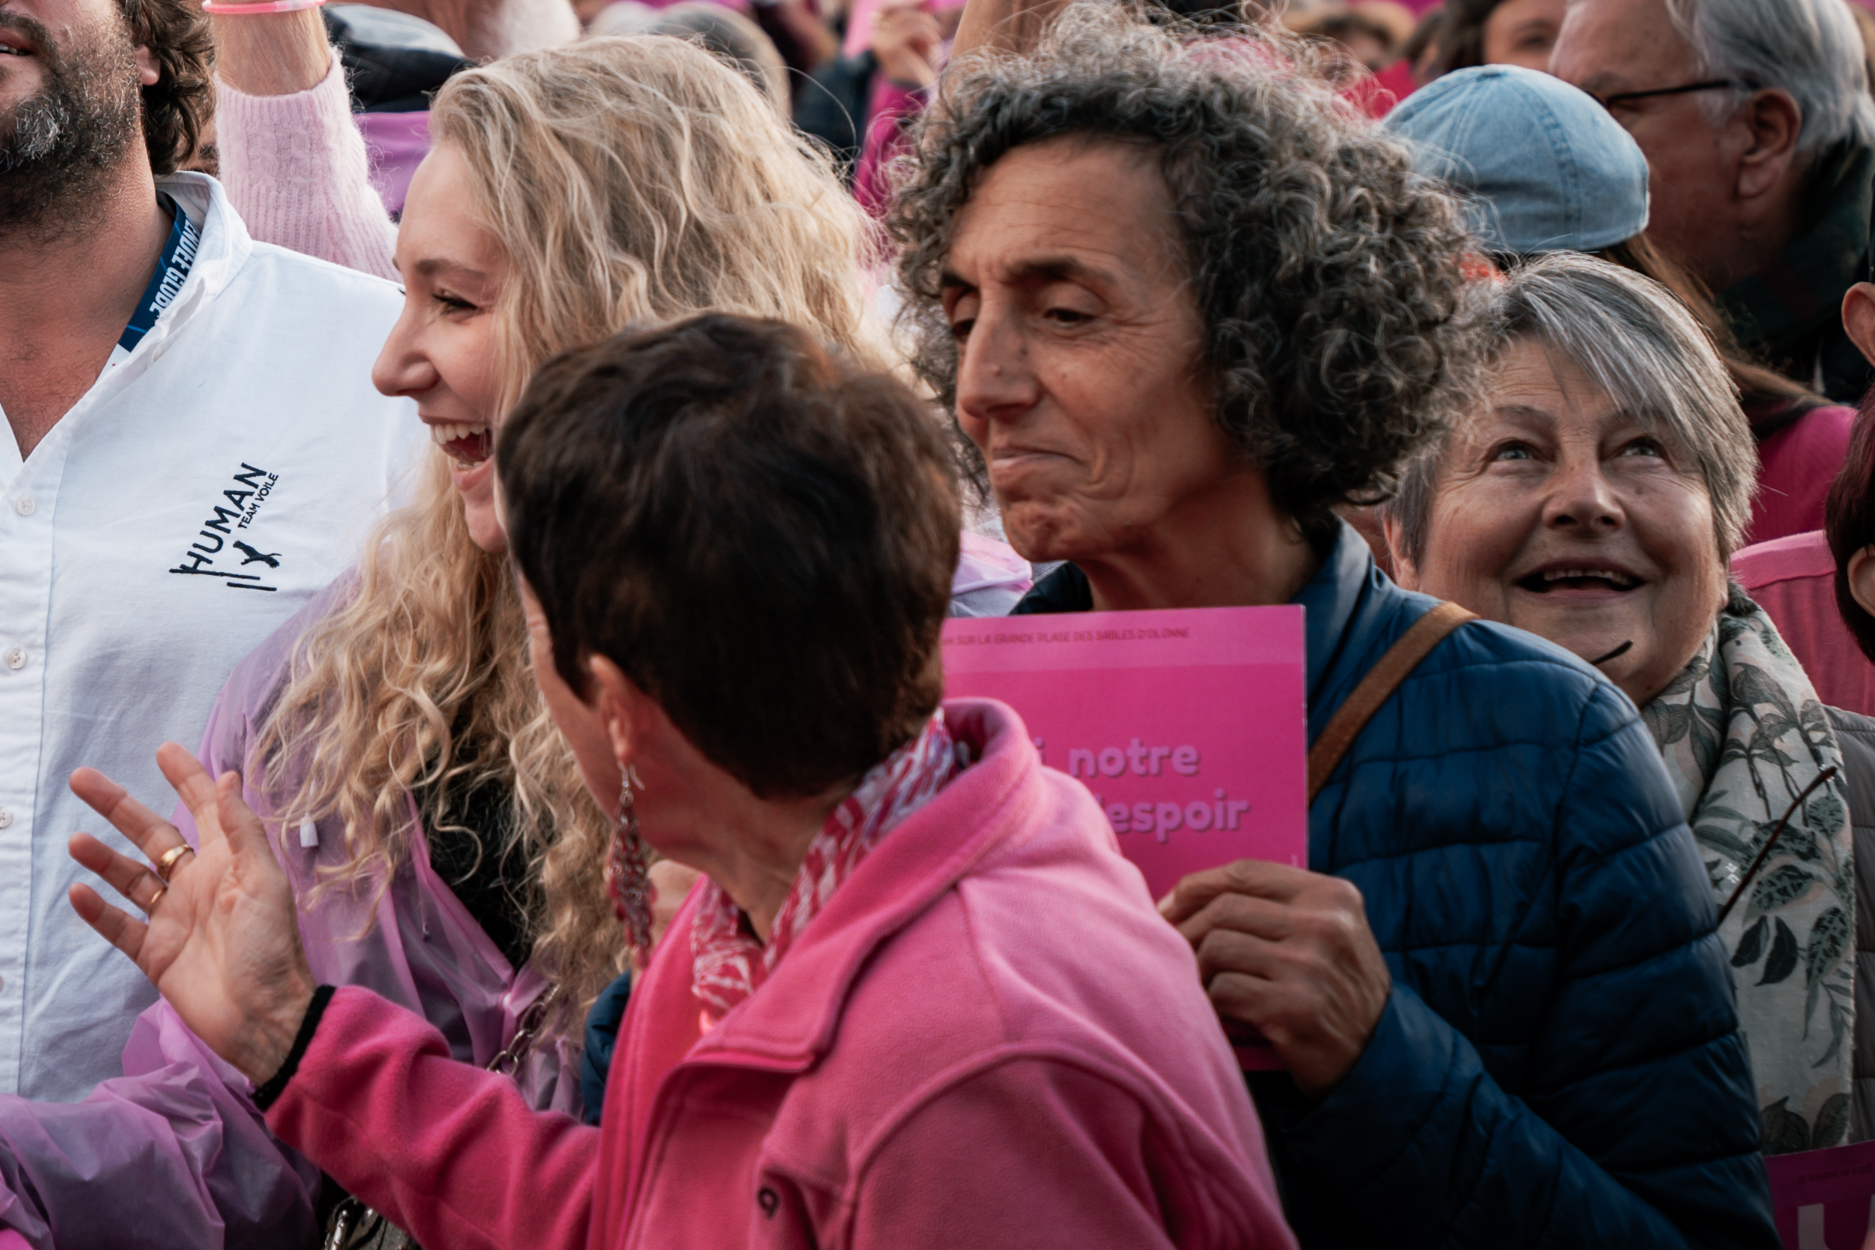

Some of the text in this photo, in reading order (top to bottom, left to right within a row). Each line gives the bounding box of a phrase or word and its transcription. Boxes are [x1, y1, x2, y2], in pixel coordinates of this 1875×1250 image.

[168, 462, 268, 575] HUMAN
[237, 472, 279, 530] TEAM VOILE
[993, 632, 1034, 645] GRANDE
[1095, 628, 1136, 640] SABLES
[1068, 737, 1200, 778] notre
